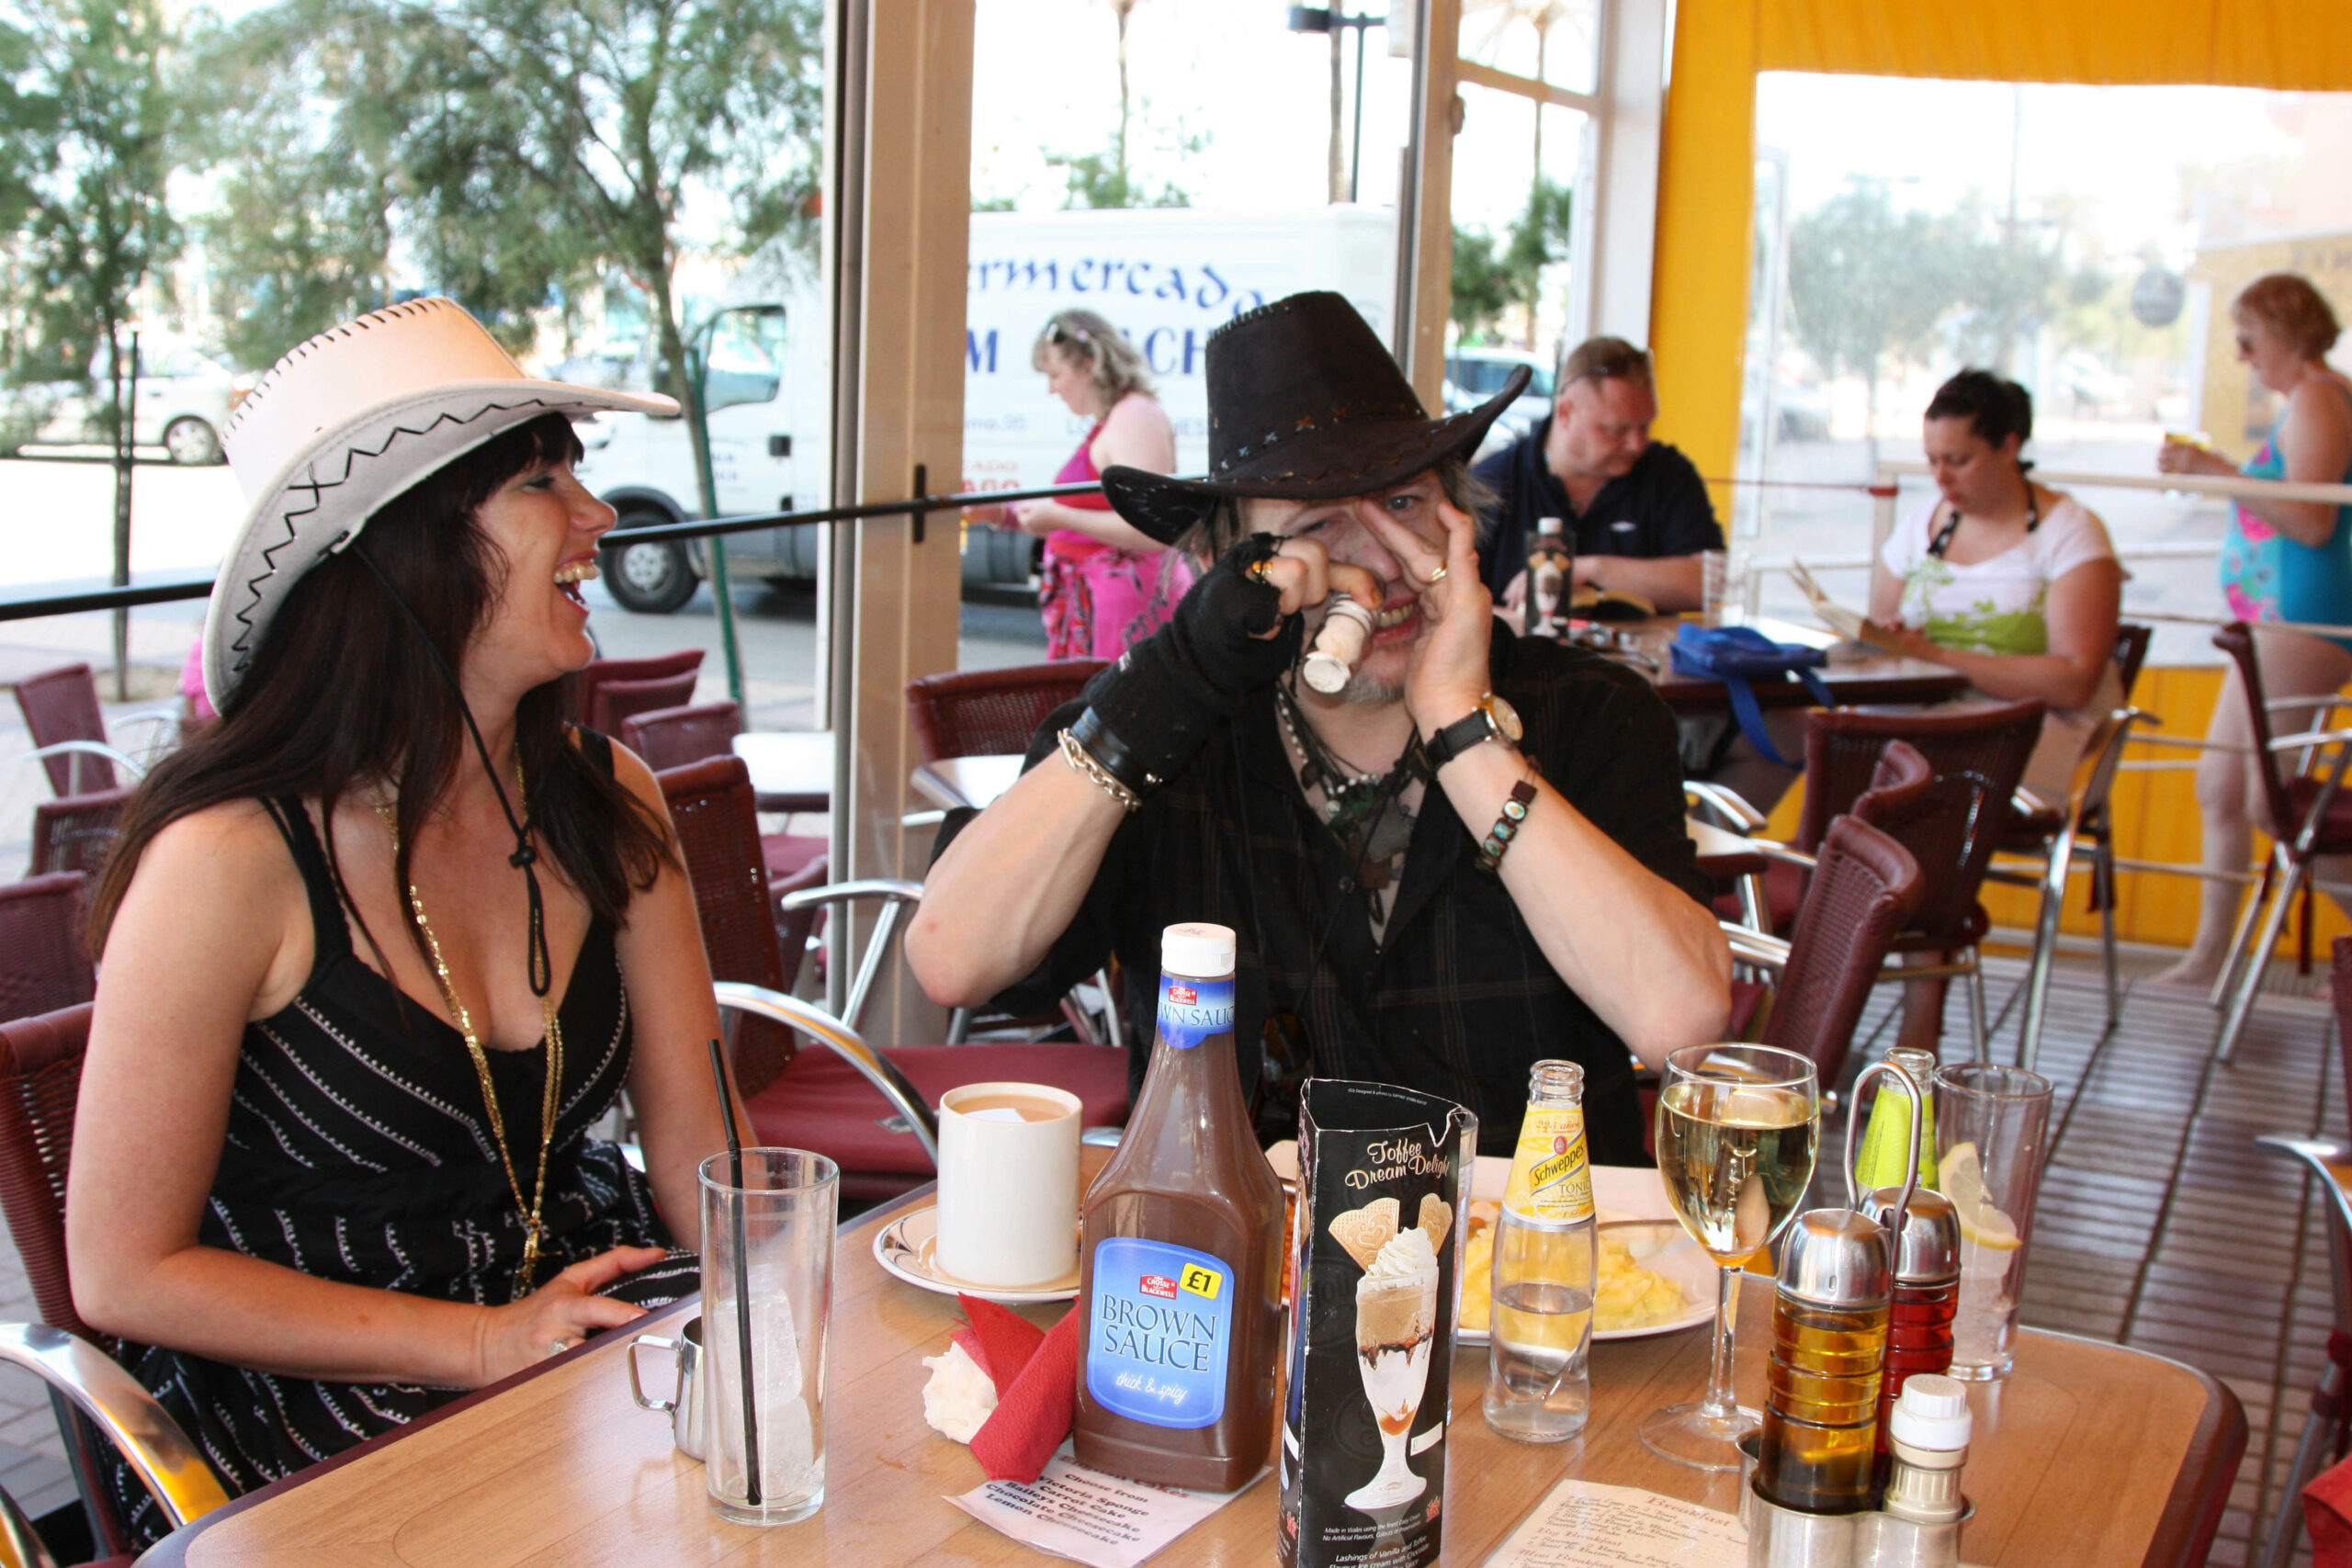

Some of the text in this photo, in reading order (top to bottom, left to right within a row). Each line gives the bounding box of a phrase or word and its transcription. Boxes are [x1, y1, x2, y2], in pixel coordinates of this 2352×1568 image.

[967, 255, 1263, 318] rmercado
[1367, 1137, 1422, 1165] Toffee
[1534, 1142, 1584, 1187] Schweppes
[1344, 1165, 1407, 1190] Dream
[1141, 1284, 1175, 1299] BLACKWELL
[1147, 1277, 1170, 1289] CROSSE
[1187, 1270, 1212, 1293] £1
[1102, 1293, 1217, 1342] BROWN
[1103, 1324, 1210, 1372] SAUCE
[1114, 1371, 1189, 1405] thick & spicy
[986, 1483, 1055, 1514] Chocolate
[1038, 1475, 1149, 1516] Victoria Sponge
[1039, 1485, 1126, 1519] Carrot Cake
[1065, 1473, 1148, 1504] Choose from
[985, 1493, 1034, 1516] Lemon
[1005, 1482, 1141, 1533] Baileys Cheesecake
[1645, 1496, 1732, 1527] Breakfast
[1335, 1554, 1368, 1563] Lashings
